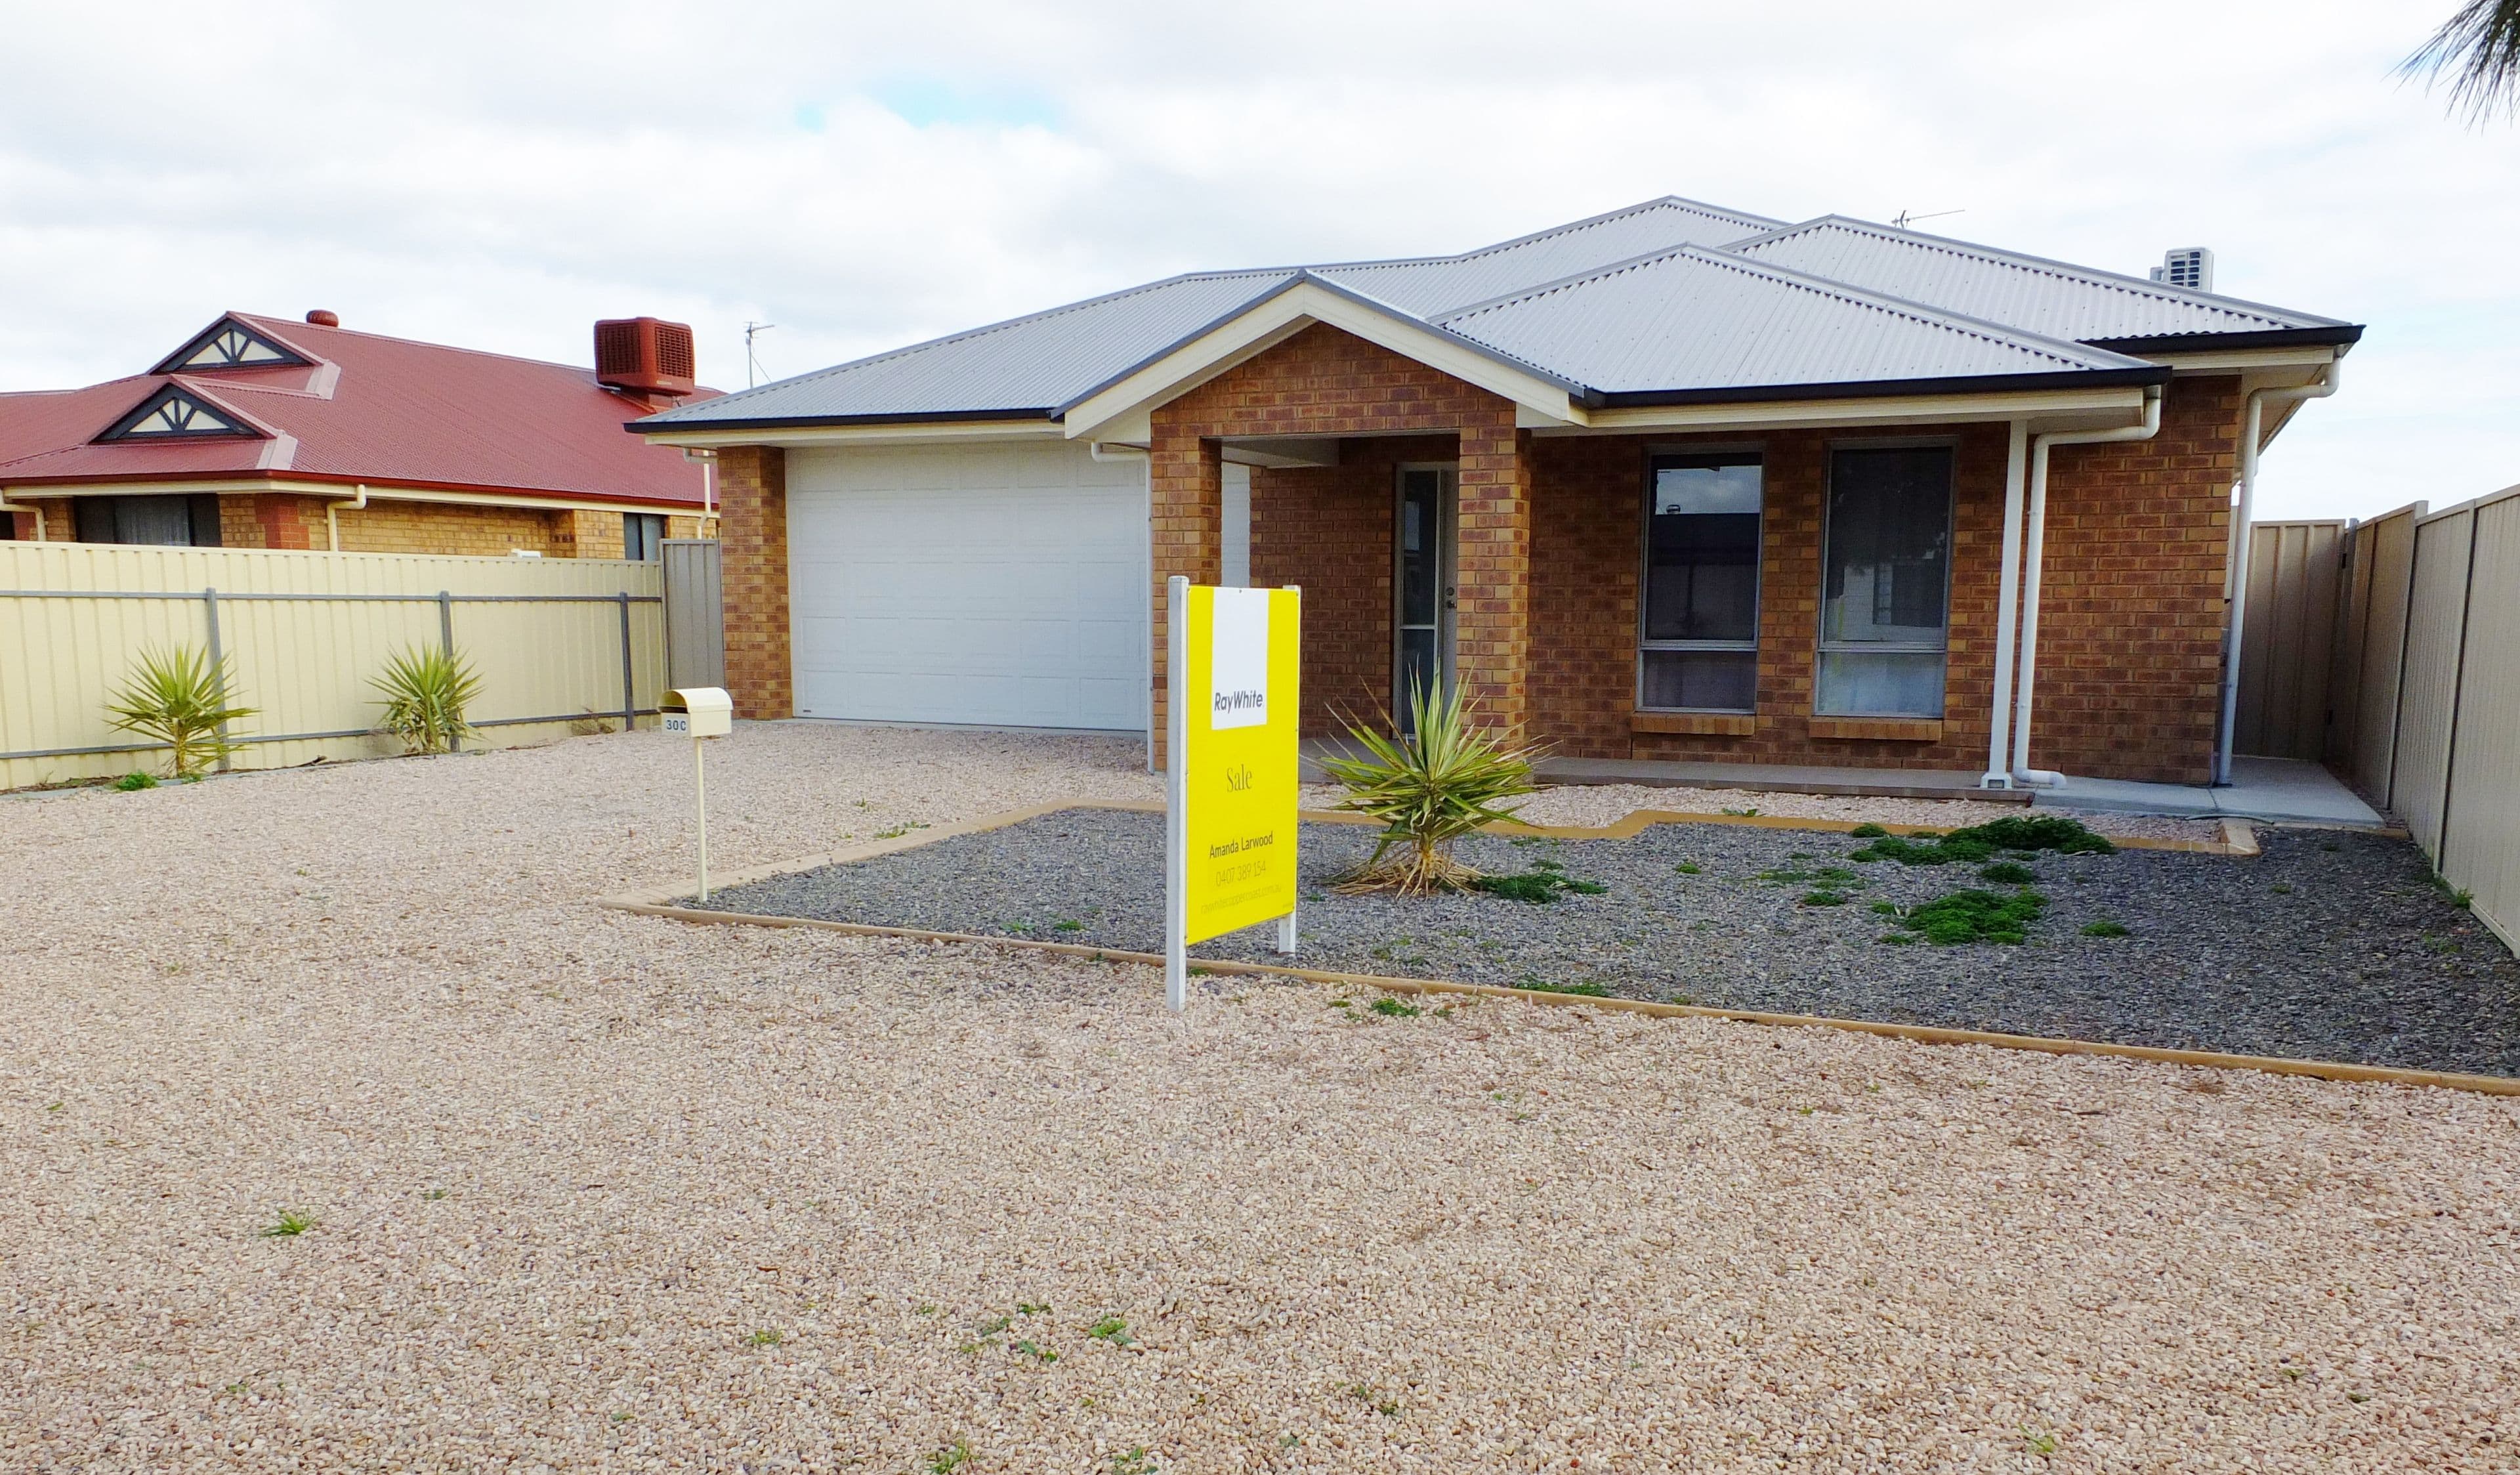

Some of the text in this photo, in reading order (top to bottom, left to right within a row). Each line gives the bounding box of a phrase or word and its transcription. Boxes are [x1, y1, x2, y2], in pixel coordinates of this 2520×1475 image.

[666, 719, 686, 731] 30C
[1226, 763, 1252, 793] Sale
[1209, 830, 1273, 859] Amanda Larwood
[1215, 860, 1266, 887] 0407 389 154
